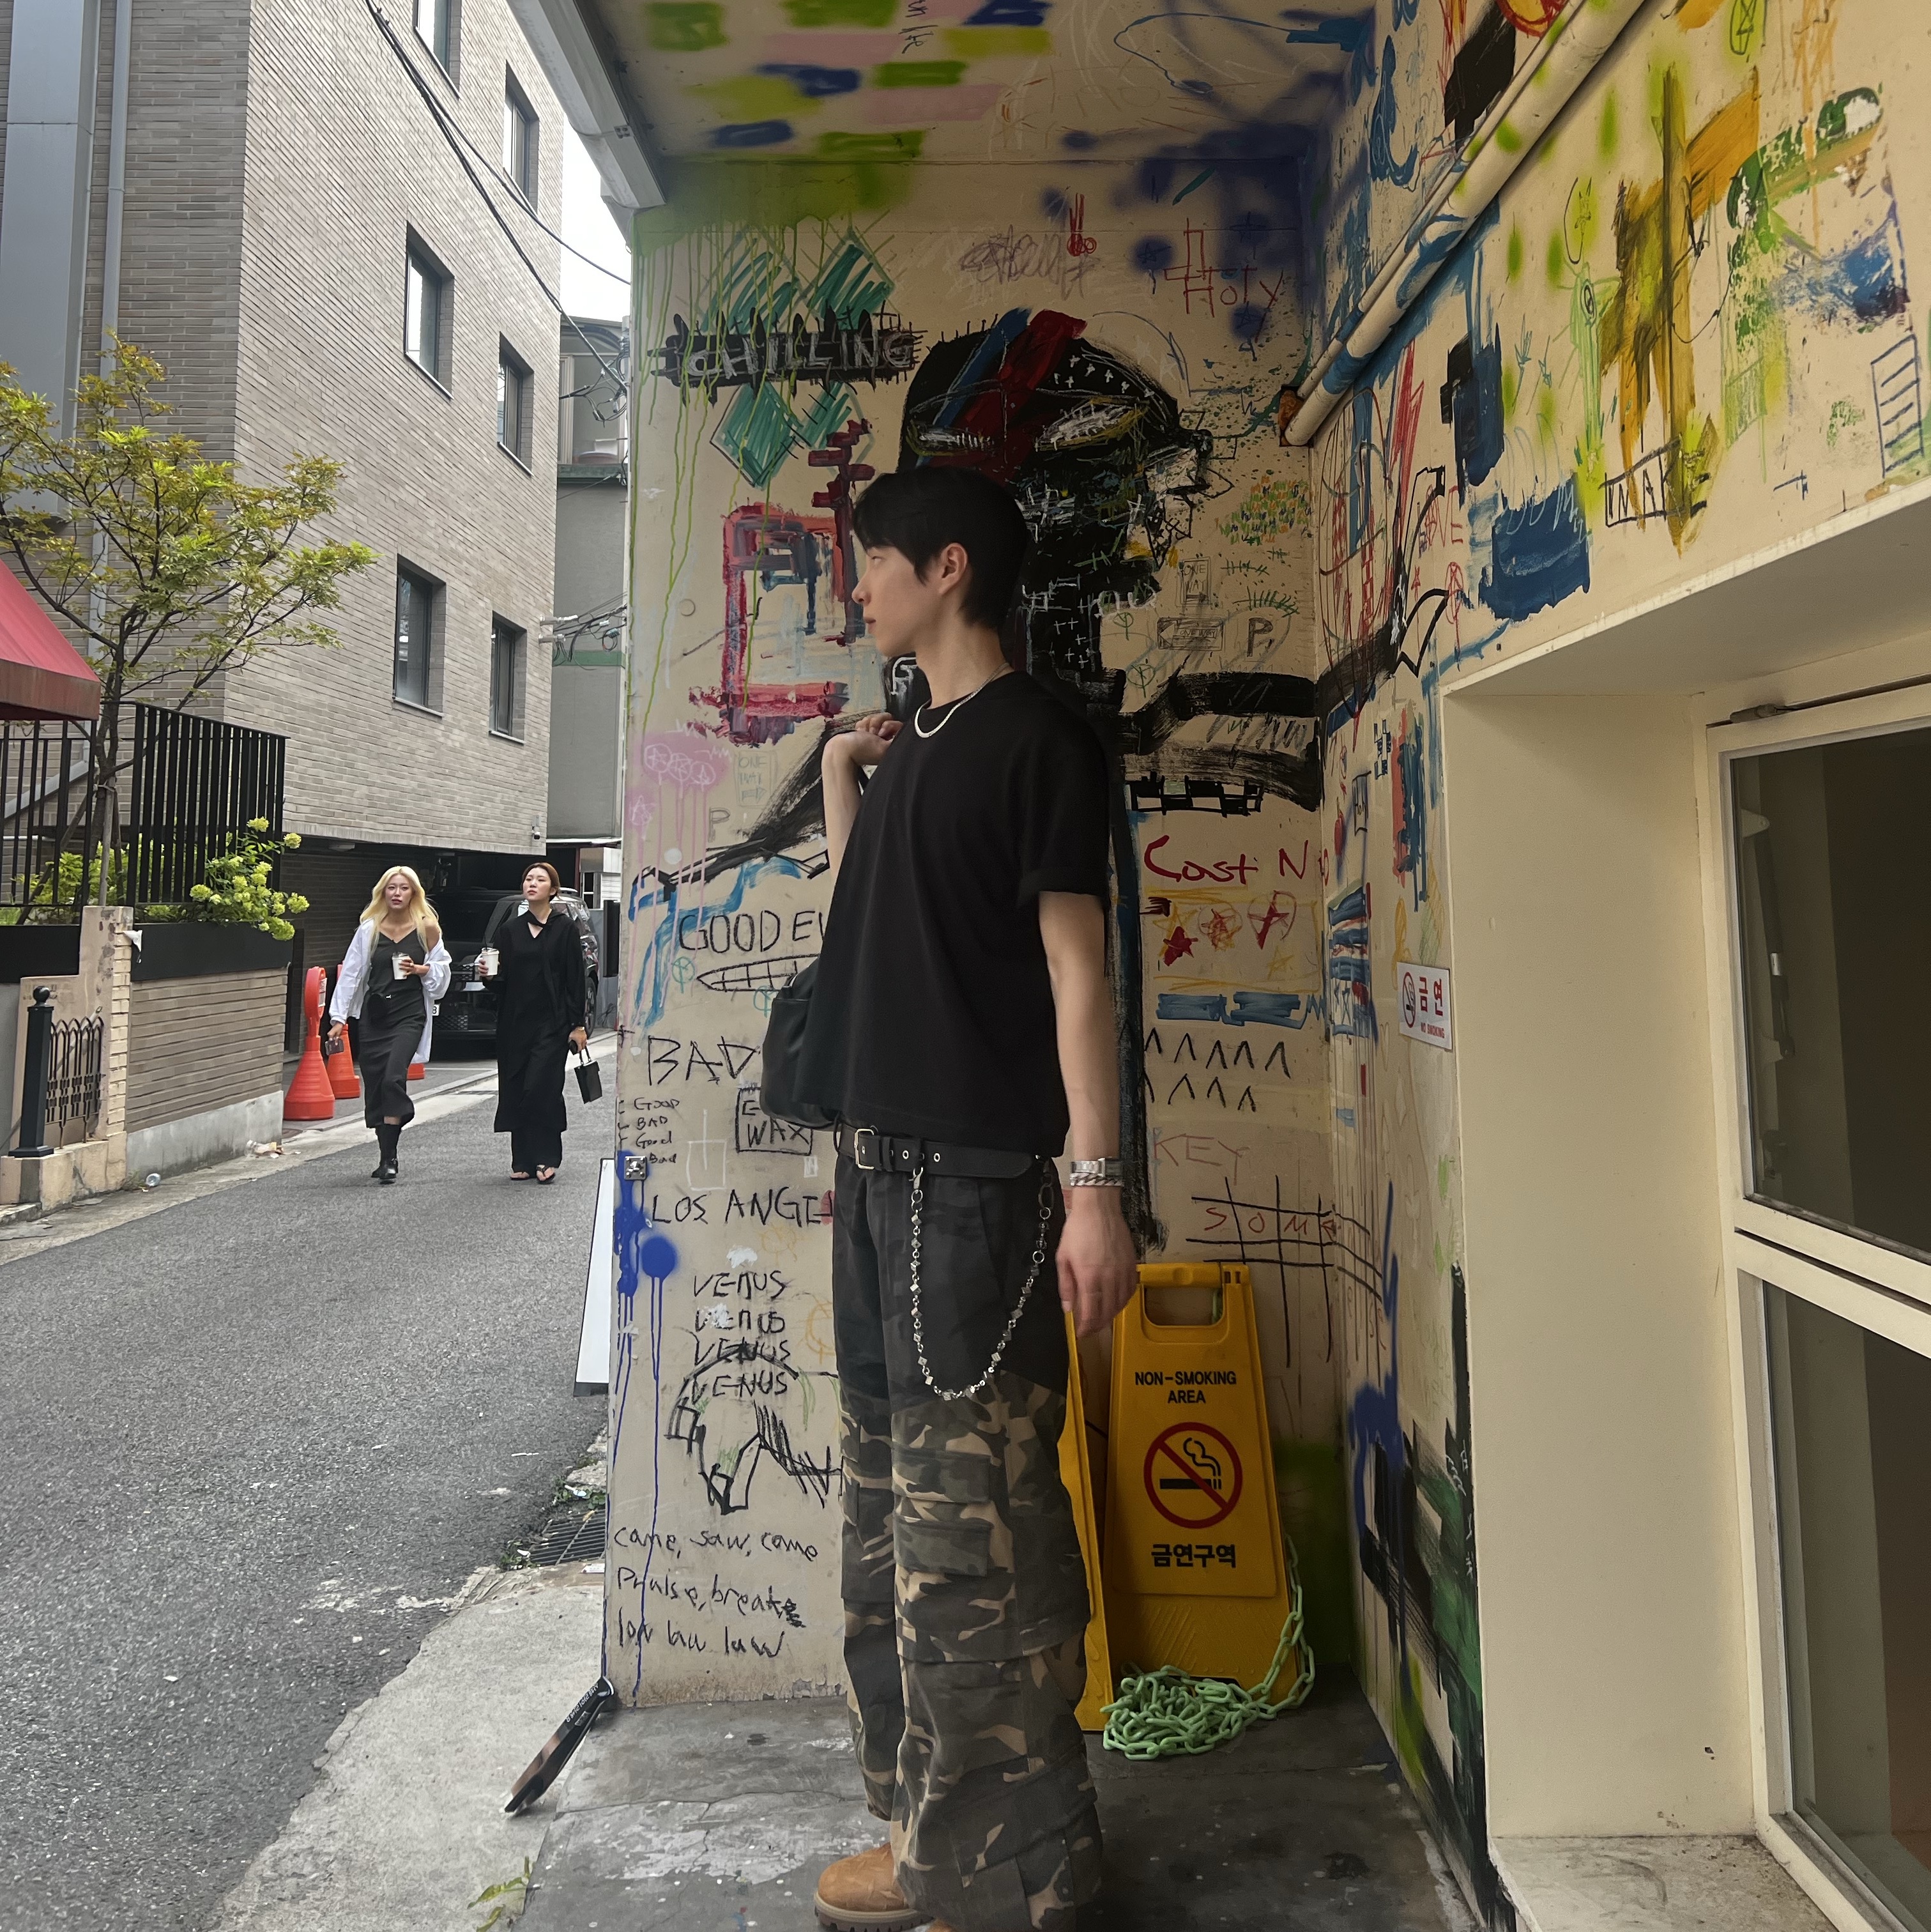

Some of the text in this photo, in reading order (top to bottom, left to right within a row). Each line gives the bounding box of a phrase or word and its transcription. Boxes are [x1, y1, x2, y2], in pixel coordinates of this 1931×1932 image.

[1184, 564, 1207, 576] ONE
[1186, 579, 1206, 593] WAY
[1247, 617, 1274, 657] P
[708, 807, 731, 843] P
[678, 910, 781, 954] GOOD
[1419, 972, 1444, 1017] 금연
[1421, 1022, 1445, 1039] NO SMOKING
[648, 1035, 761, 1086] BAD
[636, 1116, 668, 1131] BAD
[747, 1116, 809, 1148] WAX
[652, 1193, 709, 1225] LOS
[1134, 1371, 1237, 1386] NON-SMOKING
[1167, 1390, 1207, 1404] AREA
[1151, 1544, 1237, 1568] 금연구역
